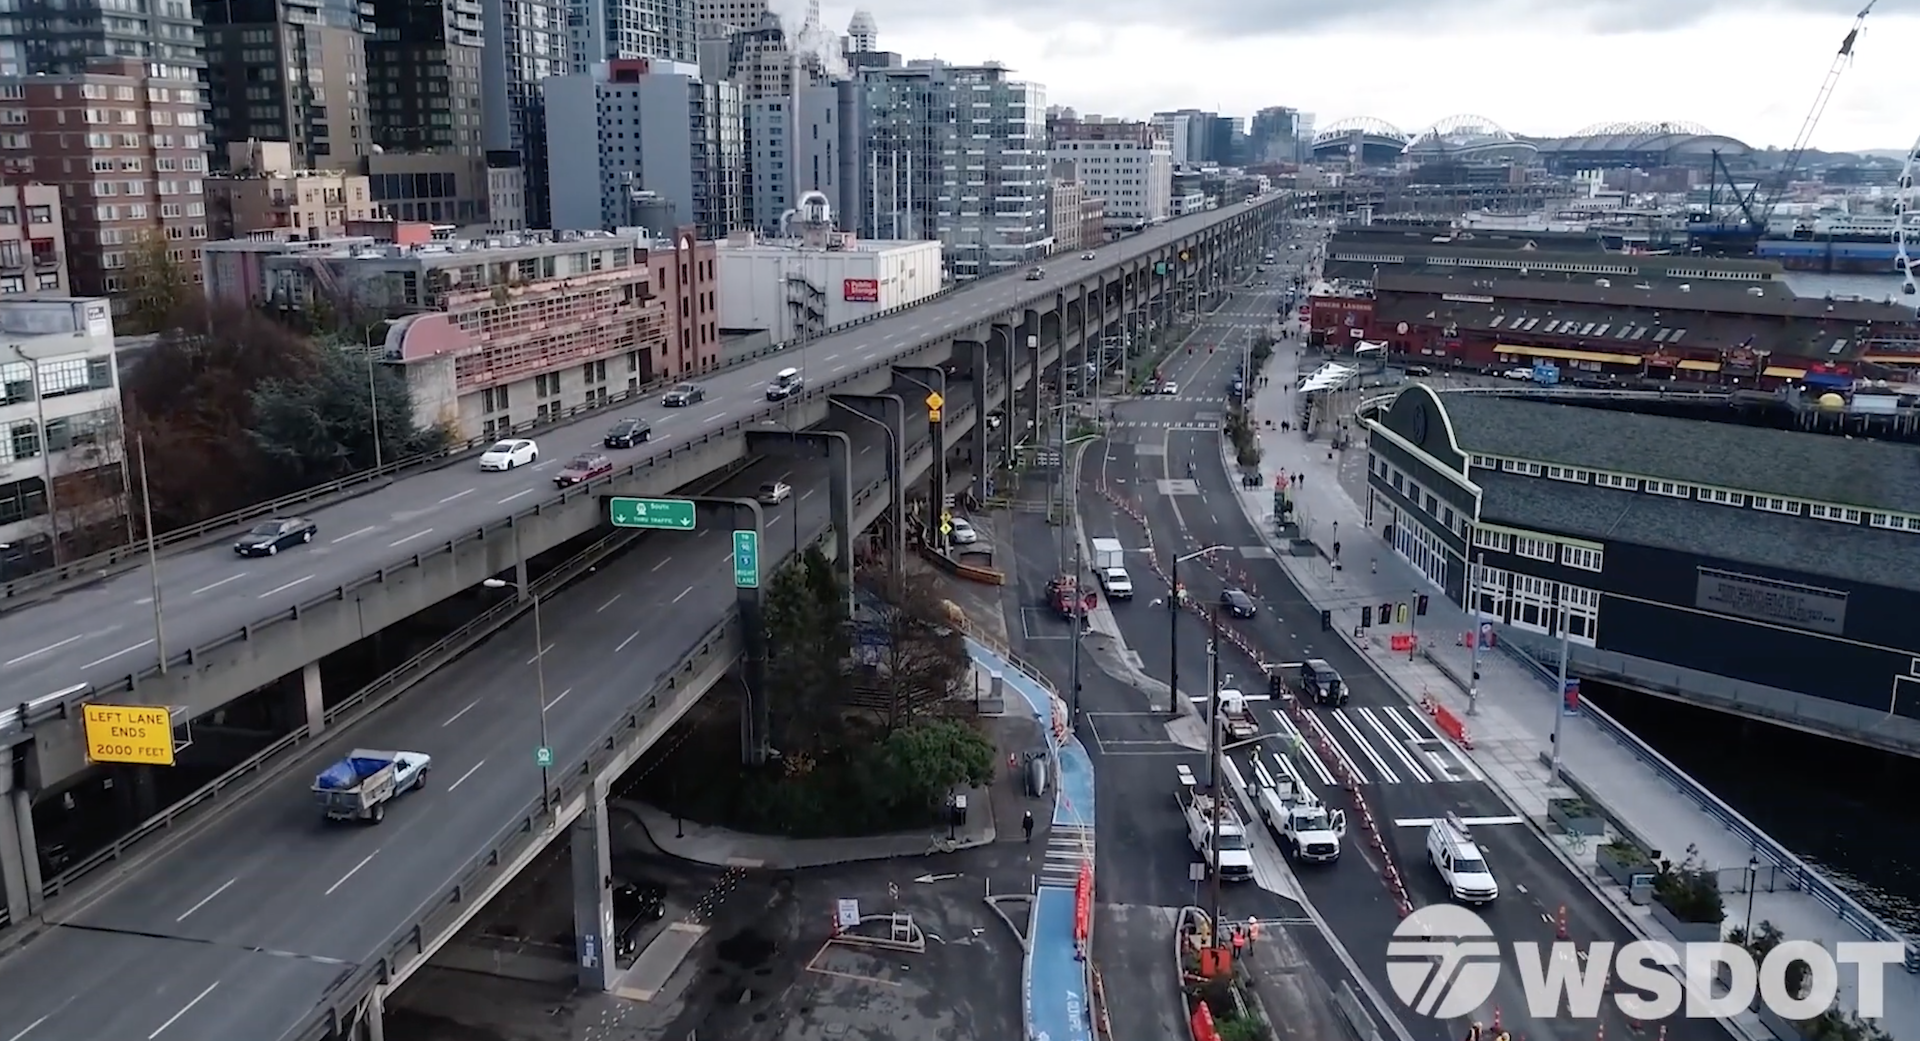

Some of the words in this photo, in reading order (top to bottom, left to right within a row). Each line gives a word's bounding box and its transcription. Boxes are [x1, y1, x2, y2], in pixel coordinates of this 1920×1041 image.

[89, 711, 122, 722] LEFT
[128, 713, 164, 725] LANE
[111, 726, 146, 738] ENDS
[97, 744, 132, 756] 2000
[138, 747, 165, 757] FEET
